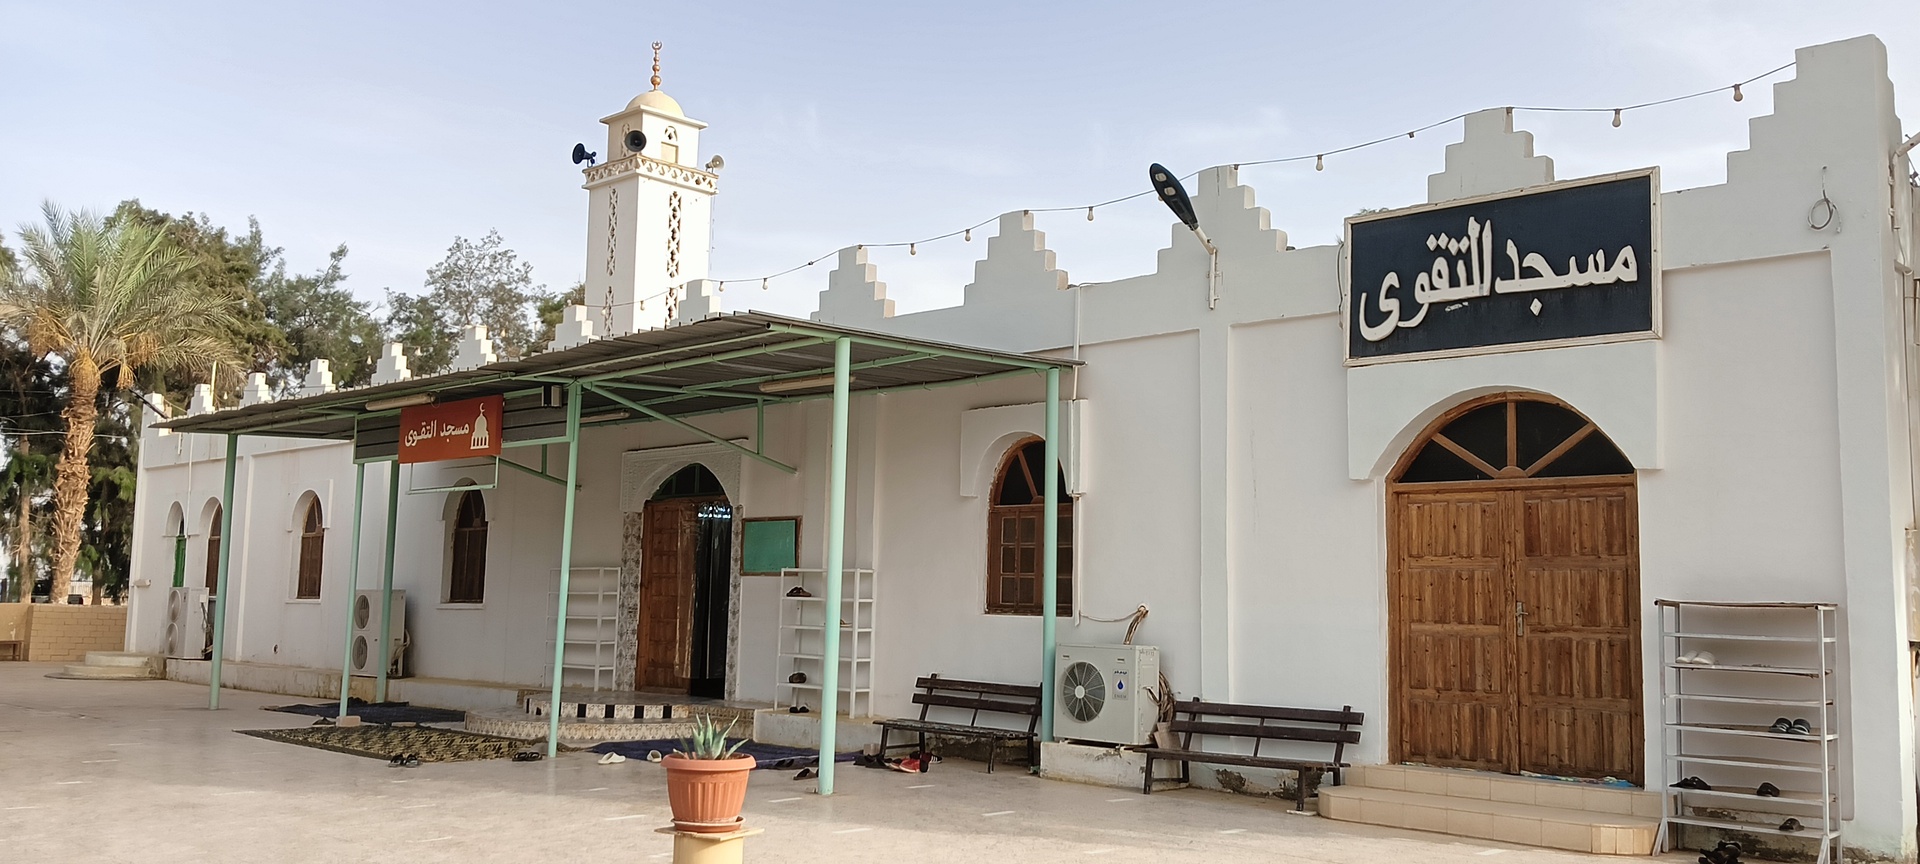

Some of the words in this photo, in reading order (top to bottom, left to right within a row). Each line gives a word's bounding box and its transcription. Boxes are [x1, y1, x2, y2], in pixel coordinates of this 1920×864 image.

[1358, 215, 1493, 342] التقوى
[1494, 238, 1638, 316] مسجد
[404, 419, 437, 447] التقوى
[440, 422, 470, 443] مسجد
